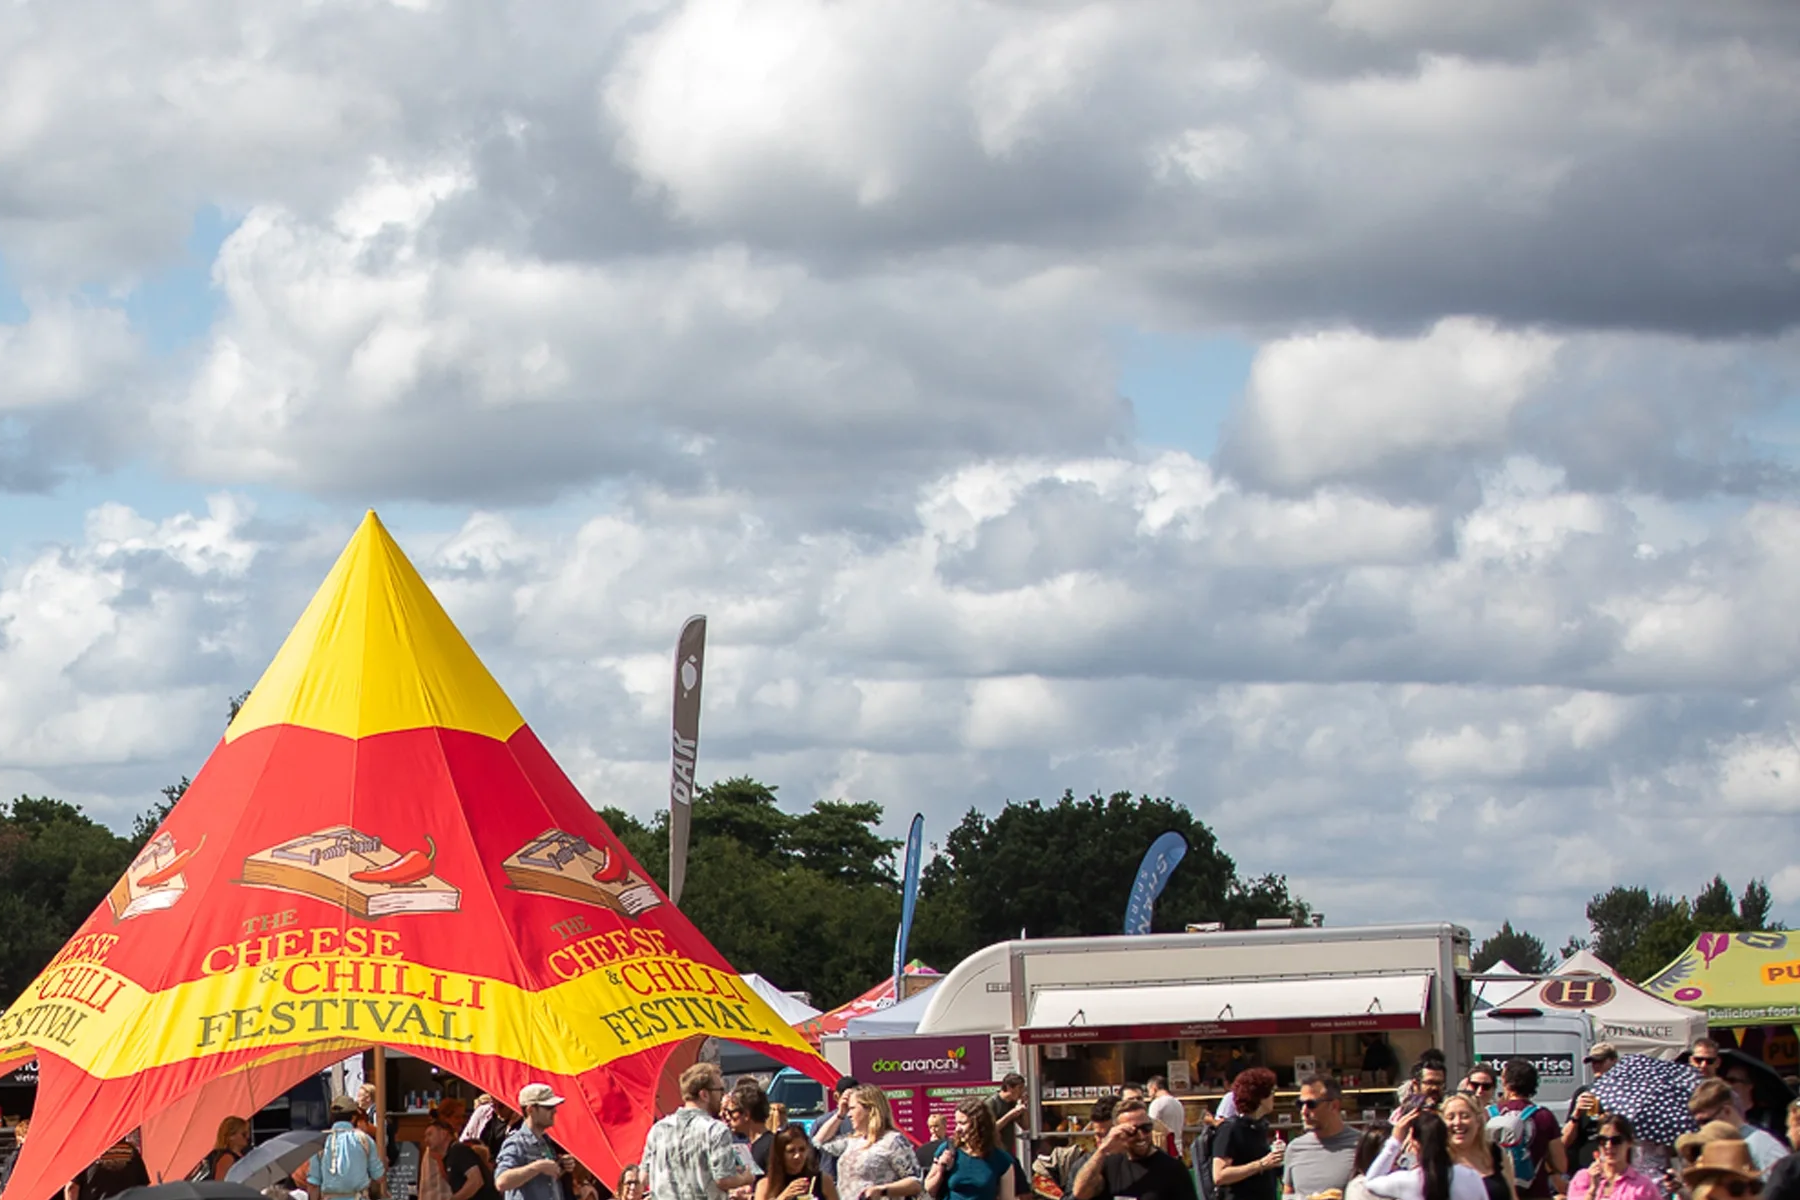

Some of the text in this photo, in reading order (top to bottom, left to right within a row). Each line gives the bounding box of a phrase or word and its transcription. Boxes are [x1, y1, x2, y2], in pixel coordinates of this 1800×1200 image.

[242, 908, 298, 934] THE
[550, 915, 592, 940] THE
[200, 927, 404, 975] CHEESE
[547, 927, 679, 981] CHEESE
[38, 966, 127, 1014] CHILLI
[258, 960, 486, 1010] & CHILLI
[605, 959, 749, 1004] & CHILLI
[1560, 980, 1594, 1002] H
[196, 998, 474, 1047] FESTIVAL
[599, 996, 773, 1046] FESTIVAL
[1627, 1026, 1673, 1038] SAUCE
[1708, 1007, 1766, 1019] Delicious
